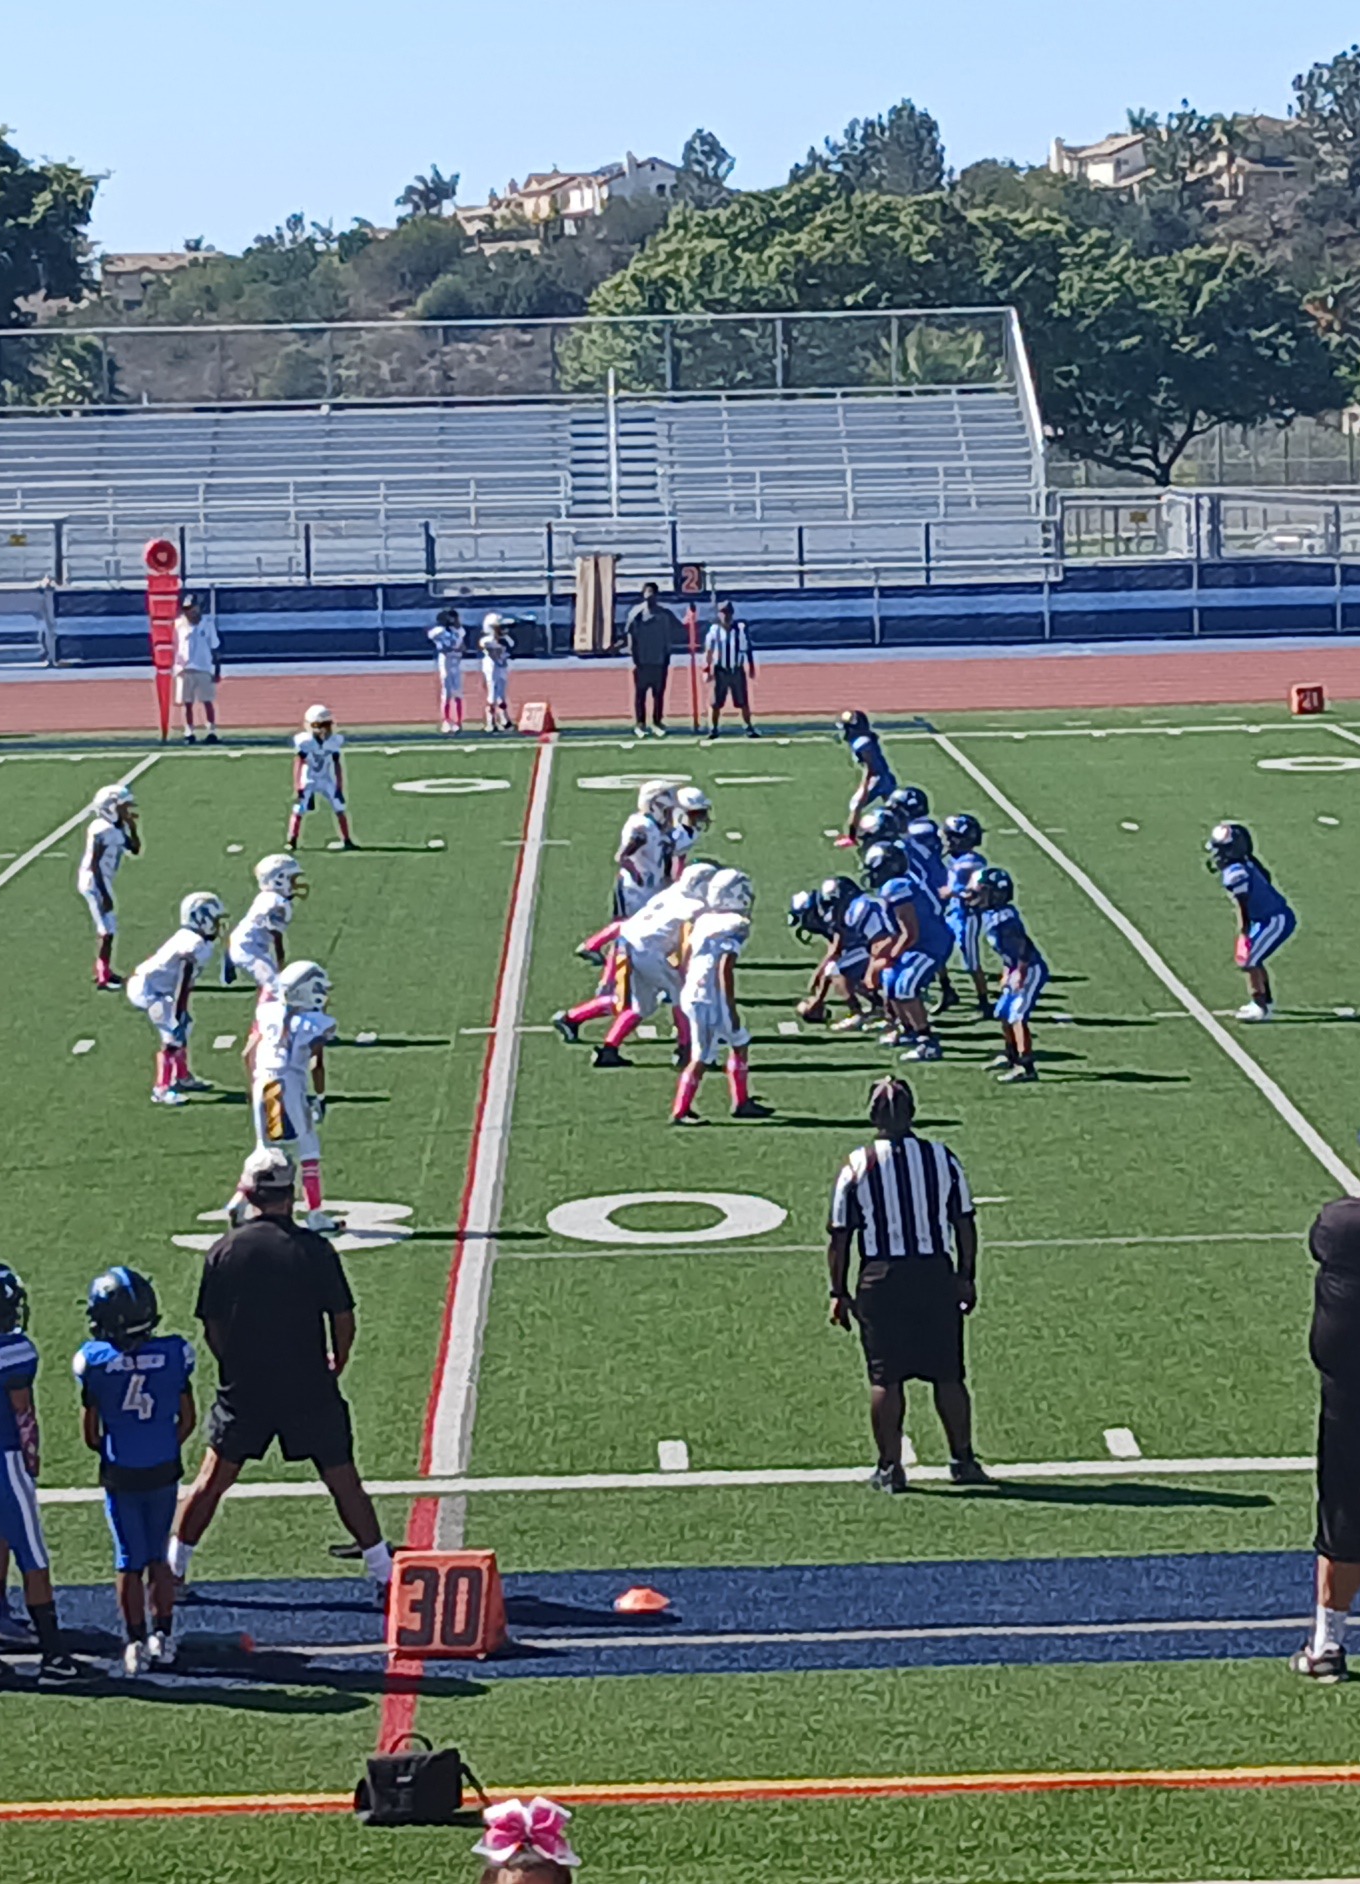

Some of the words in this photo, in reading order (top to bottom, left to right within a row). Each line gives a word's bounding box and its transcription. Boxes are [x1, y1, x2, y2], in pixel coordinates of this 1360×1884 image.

[681, 566, 699, 593] 2
[545, 1190, 789, 1245] 0
[121, 1373, 155, 1421] 4
[395, 1564, 484, 1647] 30
